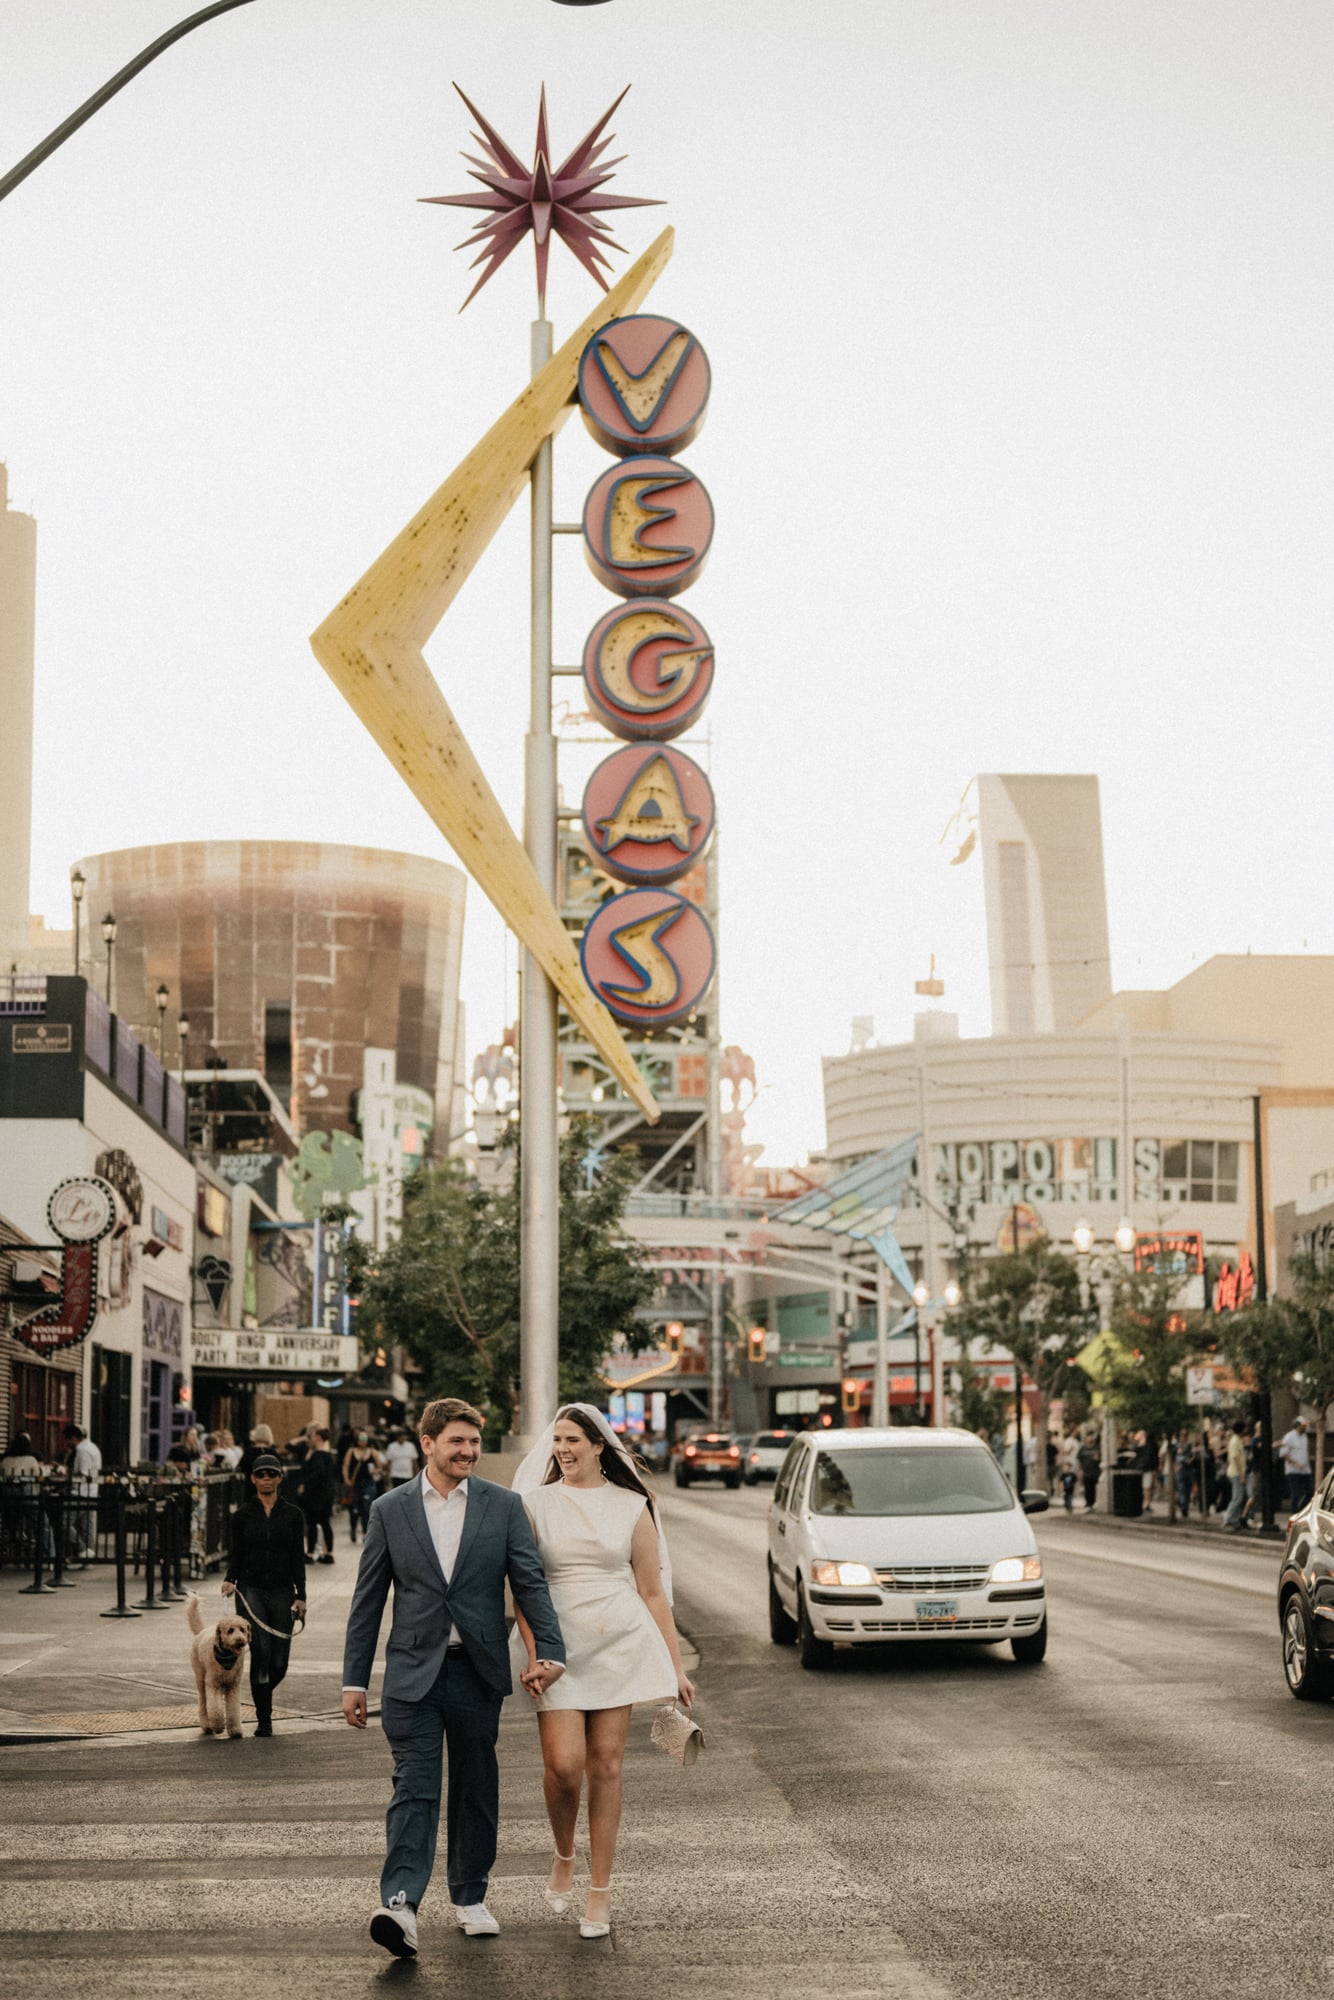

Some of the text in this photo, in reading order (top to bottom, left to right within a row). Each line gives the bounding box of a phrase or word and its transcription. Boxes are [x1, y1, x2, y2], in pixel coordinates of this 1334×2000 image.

[594, 326, 715, 1010] VEGAS
[31, 1325, 73, 1335] NOODLES
[40, 1334, 58, 1343] BAR
[236, 1335, 265, 1349] BINGO
[276, 1336, 340, 1351] ANNIVERSARY
[195, 1349, 228, 1364] PARTY
[236, 1352, 259, 1365] THUR
[268, 1353, 289, 1365] MAY
